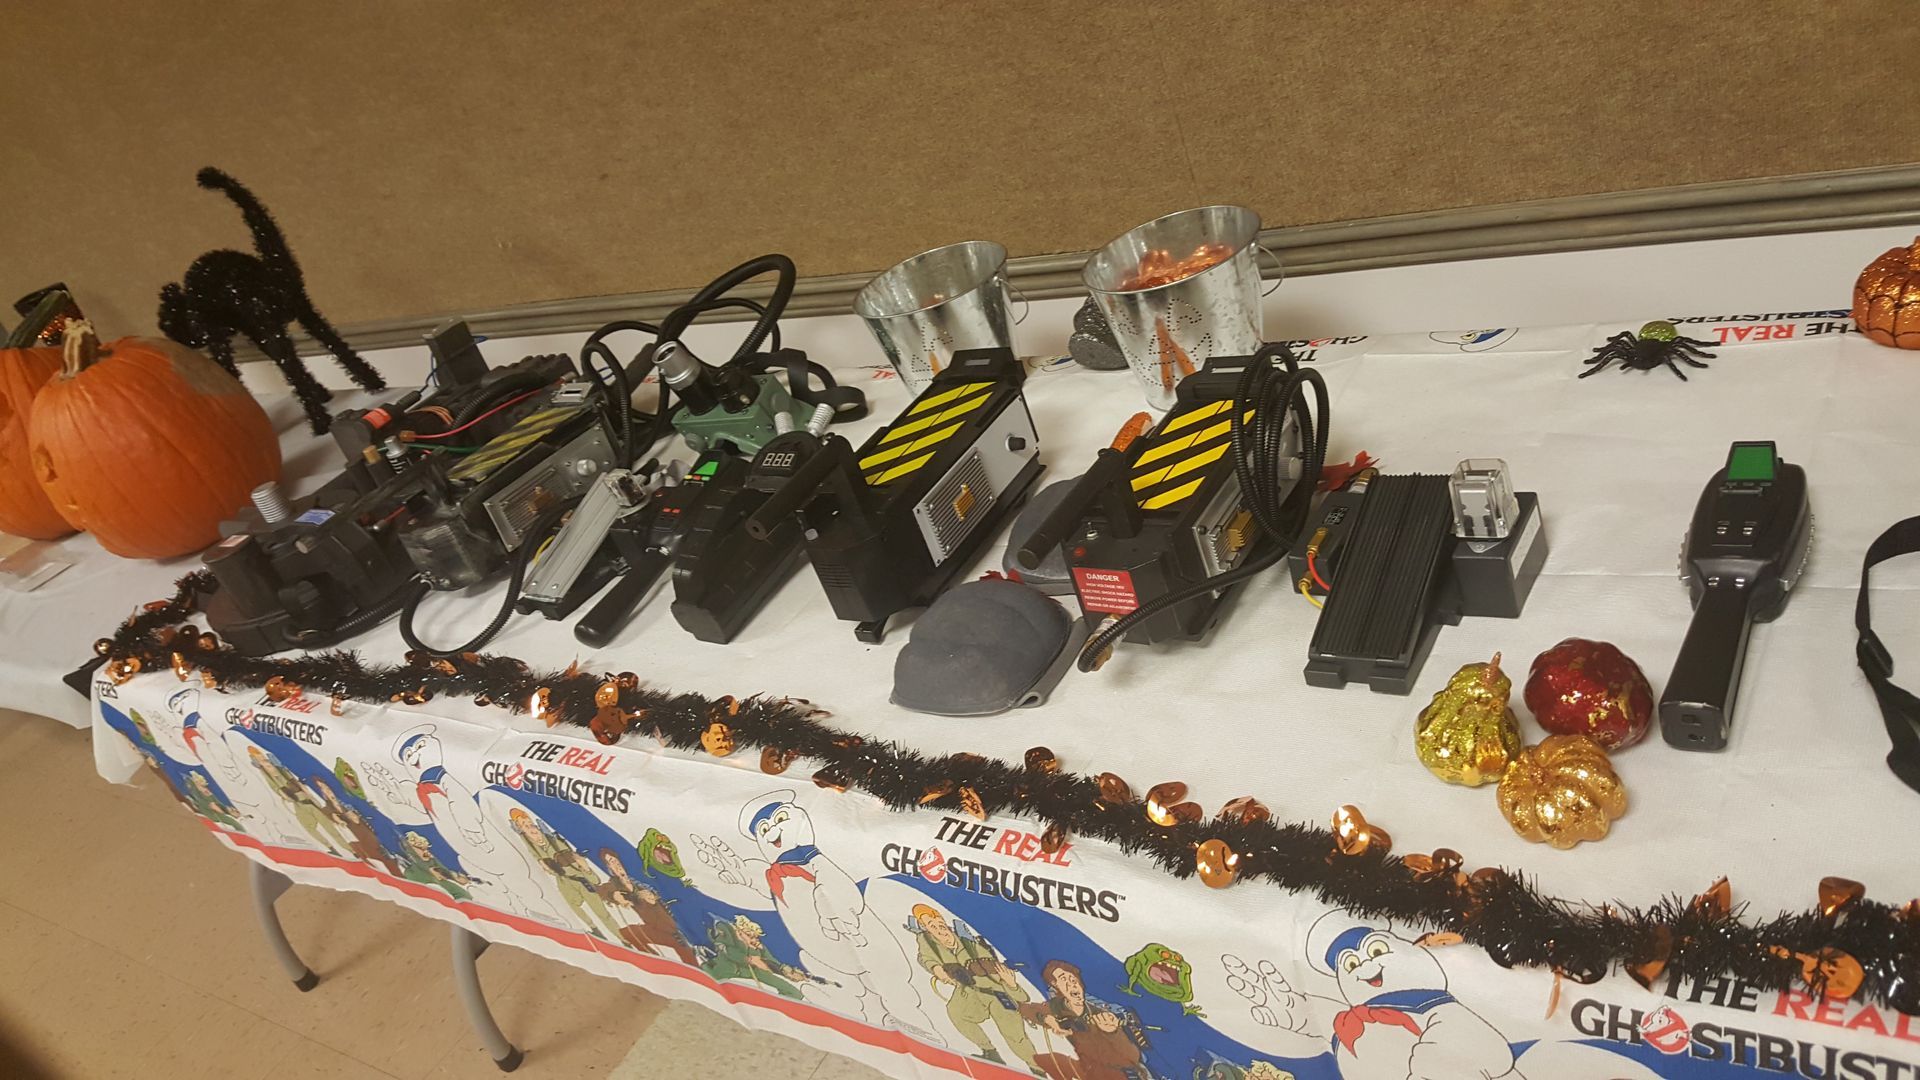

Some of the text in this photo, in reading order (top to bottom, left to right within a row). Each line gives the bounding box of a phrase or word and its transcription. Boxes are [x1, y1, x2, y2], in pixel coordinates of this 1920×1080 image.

[1711, 321, 1866, 346] THE REAL
[762, 452, 796, 467] 888
[1085, 573, 1120, 582] DANGER
[279, 688, 321, 714] REAL
[520, 740, 616, 775] THE REAL
[934, 816, 1075, 868] THE REAL
[1663, 963, 1920, 1043] THE REAL
[1570, 997, 1920, 1080] GHOSTBUST
